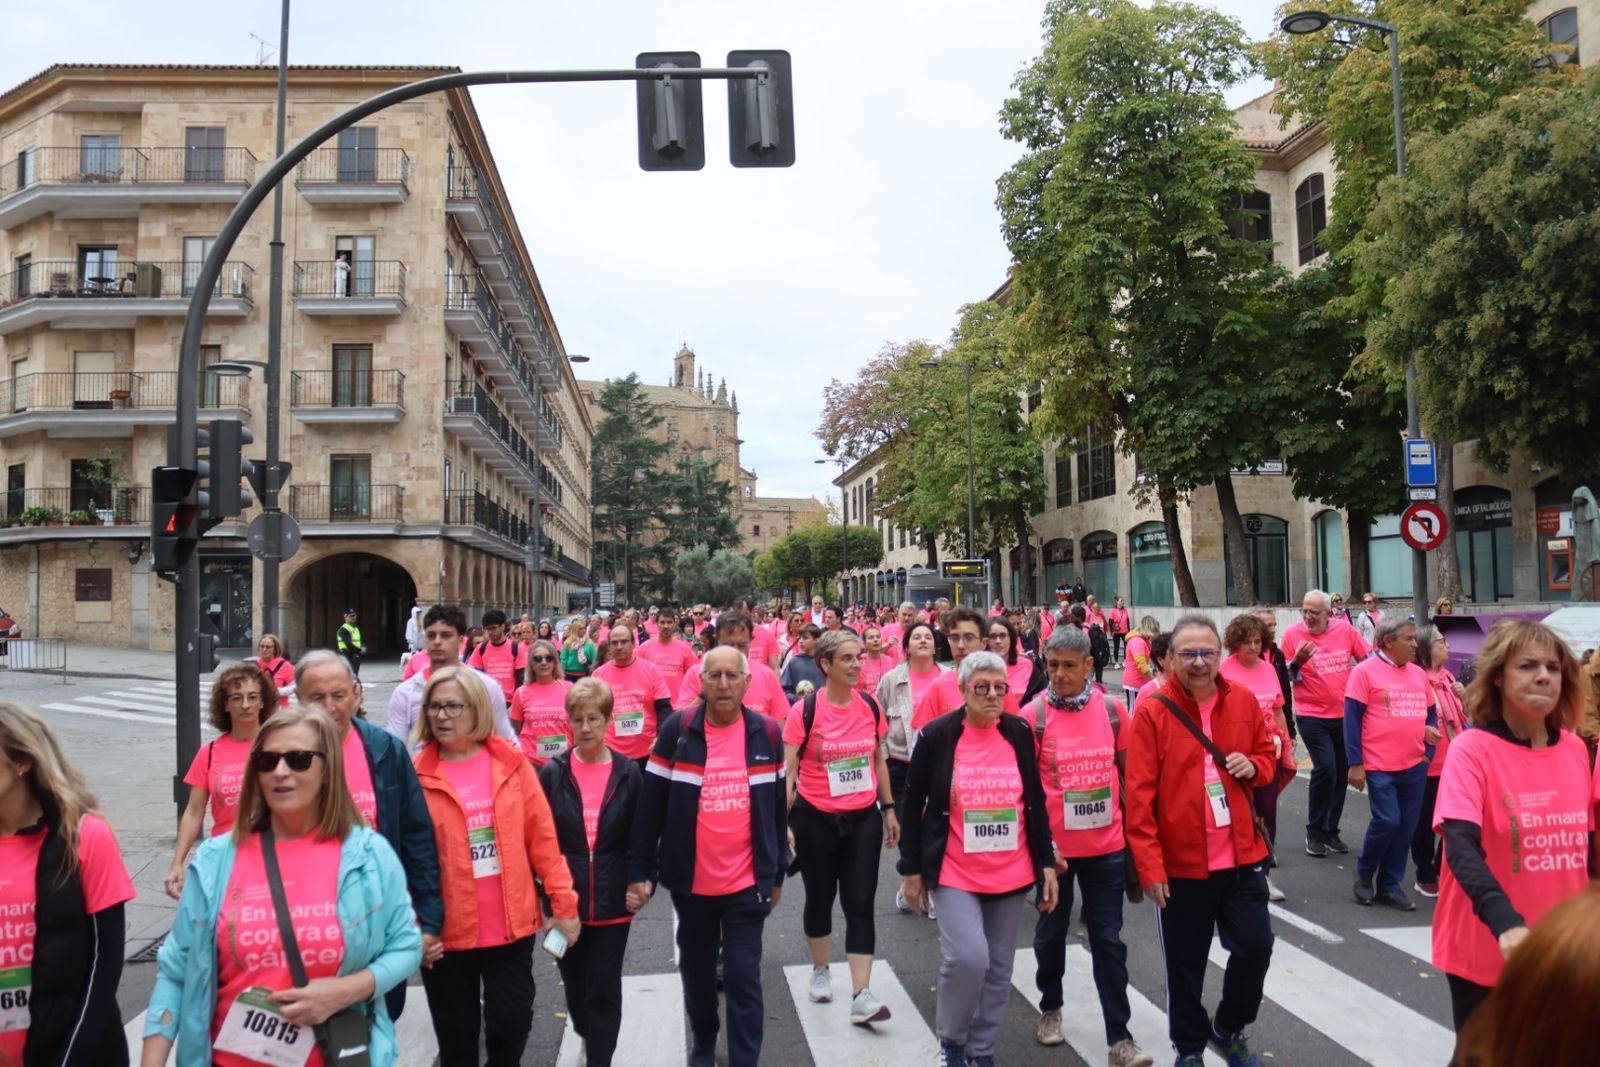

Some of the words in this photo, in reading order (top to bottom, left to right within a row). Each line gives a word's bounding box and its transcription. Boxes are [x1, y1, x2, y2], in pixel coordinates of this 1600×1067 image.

[958, 765, 974, 776] En
[1058, 759, 1104, 774] contra
[838, 769, 863, 783] 5236
[958, 776, 1007, 790] contra
[701, 782, 750, 797] contra
[702, 795, 751, 813] cánc
[1073, 801, 1106, 816] 10646
[1520, 812, 1543, 829] En
[973, 823, 1009, 838] 10645
[1523, 848, 1588, 873] cánc
[240, 905, 267, 923] En
[242, 1009, 302, 1046] 10815
